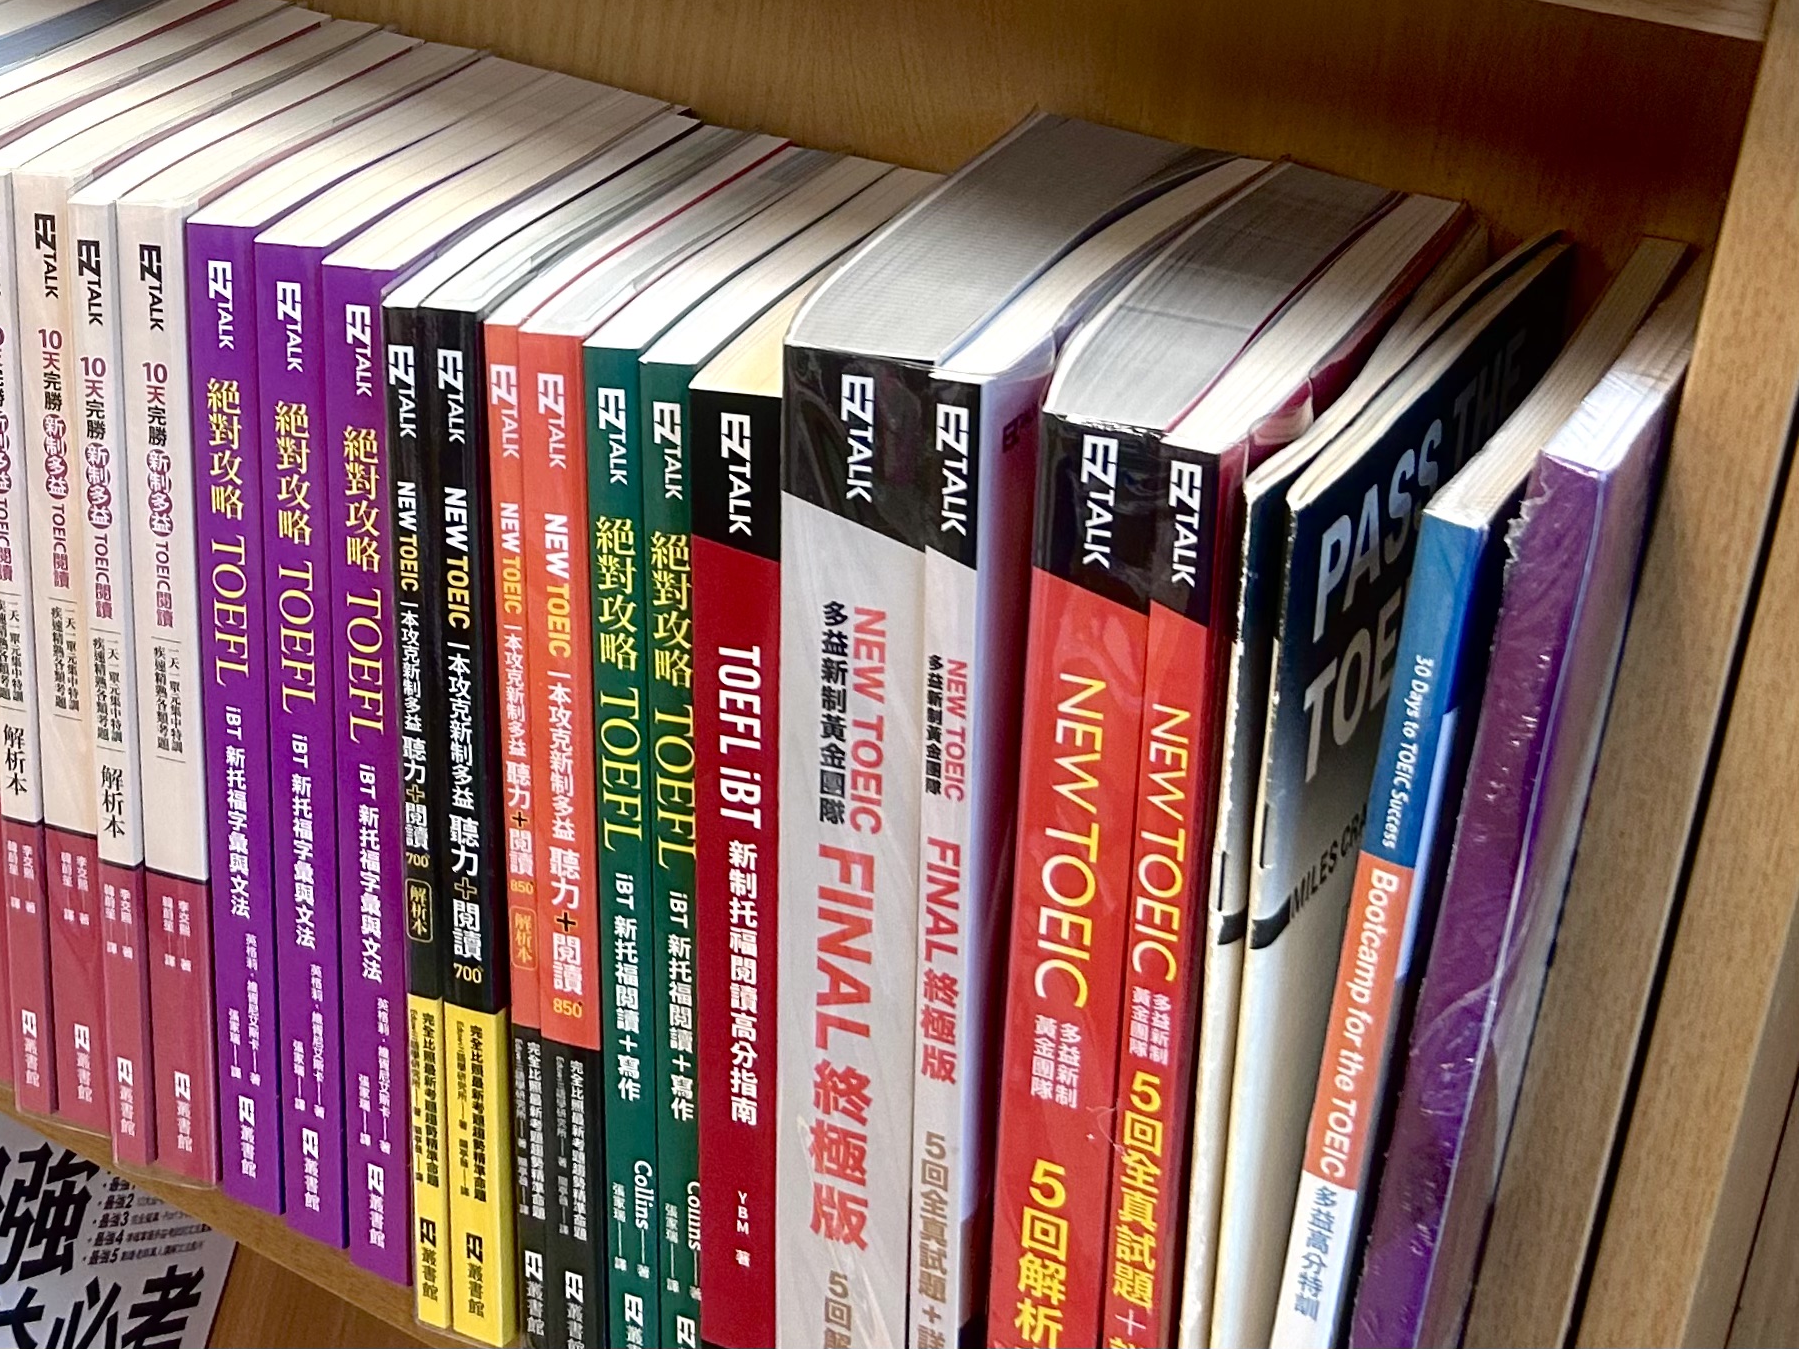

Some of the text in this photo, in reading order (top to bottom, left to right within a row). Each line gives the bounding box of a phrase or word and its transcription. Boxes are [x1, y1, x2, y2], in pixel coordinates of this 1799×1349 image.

[206, 377, 244, 520] 絕對攻略
[444, 486, 469, 551] NEW
[211, 536, 250, 688] TOEFL
[446, 556, 470, 629] TOEIC
[595, 514, 638, 673] 絕對攻略
[3, 724, 27, 795] 解析本
[224, 705, 243, 740] iBT
[447, 641, 474, 810] 一本攻克新制多益
[717, 644, 762, 753] TOEFL
[1382, 679, 1430, 850] Days TOEIC Success
[599, 689, 643, 852] TOEFL
[718, 762, 761, 828] iBT
[1034, 672, 1107, 1009] NEW TOEIC
[614, 872, 635, 910] iBT
[809, 605, 887, 1252] NEW TOEIC FINAL 終極版
[1345, 864, 1398, 1009] Bootcamp
[728, 840, 758, 1126] 新制托福閱讀高分指南
[633, 1160, 652, 1230] Collins
[1318, 1100, 1359, 1179] TOEIC
